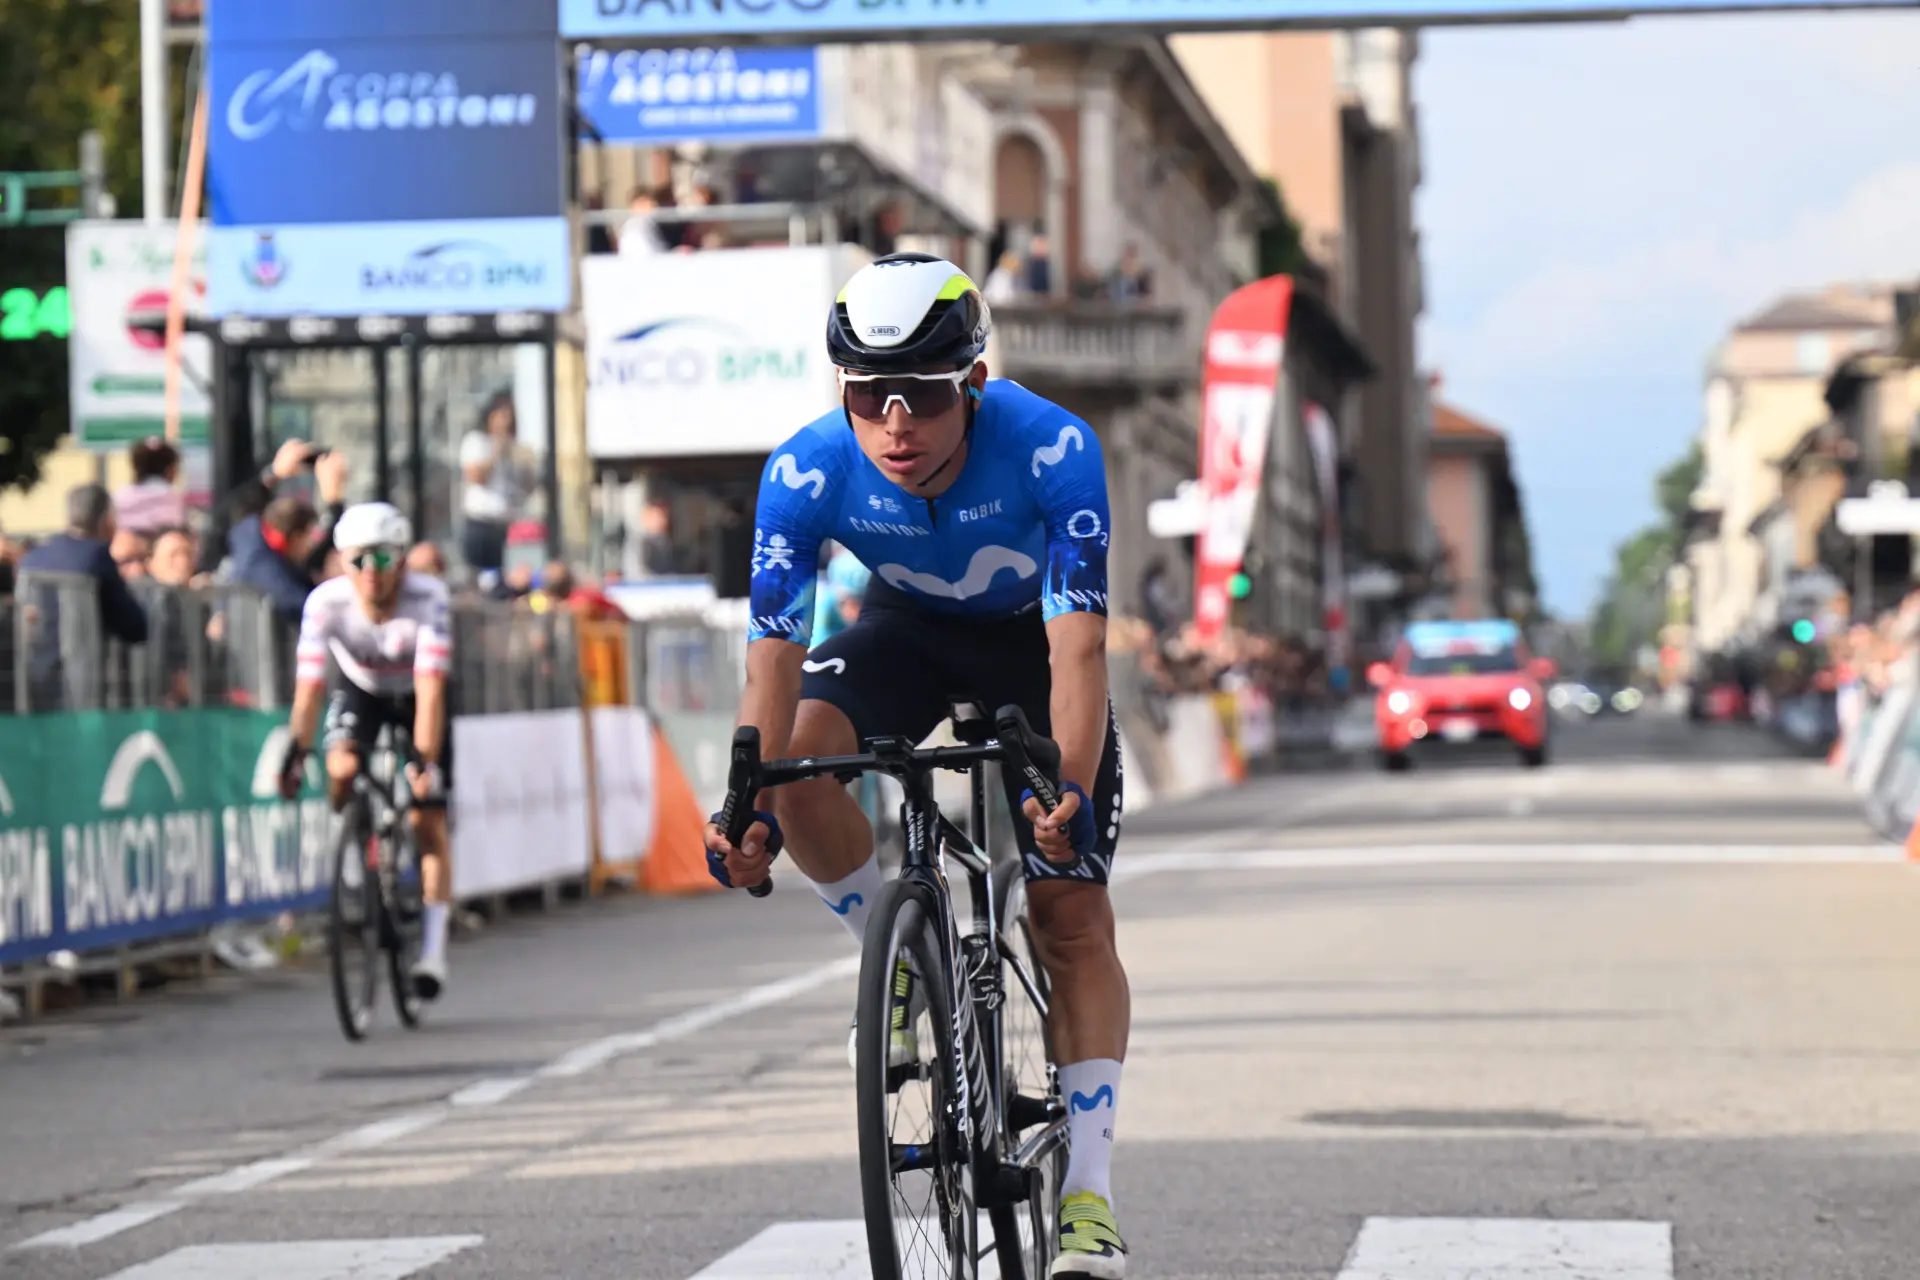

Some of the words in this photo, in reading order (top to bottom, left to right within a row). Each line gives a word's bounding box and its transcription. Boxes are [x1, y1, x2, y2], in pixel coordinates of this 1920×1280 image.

[328, 72, 458, 98] COPPA
[324, 93, 537, 130] AGOSTONI
[361, 264, 473, 290] BANCO
[483, 262, 545, 286] BPM
[717, 345, 808, 383] BPM
[849, 516, 930, 537] CANYON
[959, 499, 1003, 523] GOBIK
[719, 788, 738, 834] RAM
[64, 816, 159, 931] BANCO
[164, 812, 213, 913] BPM
